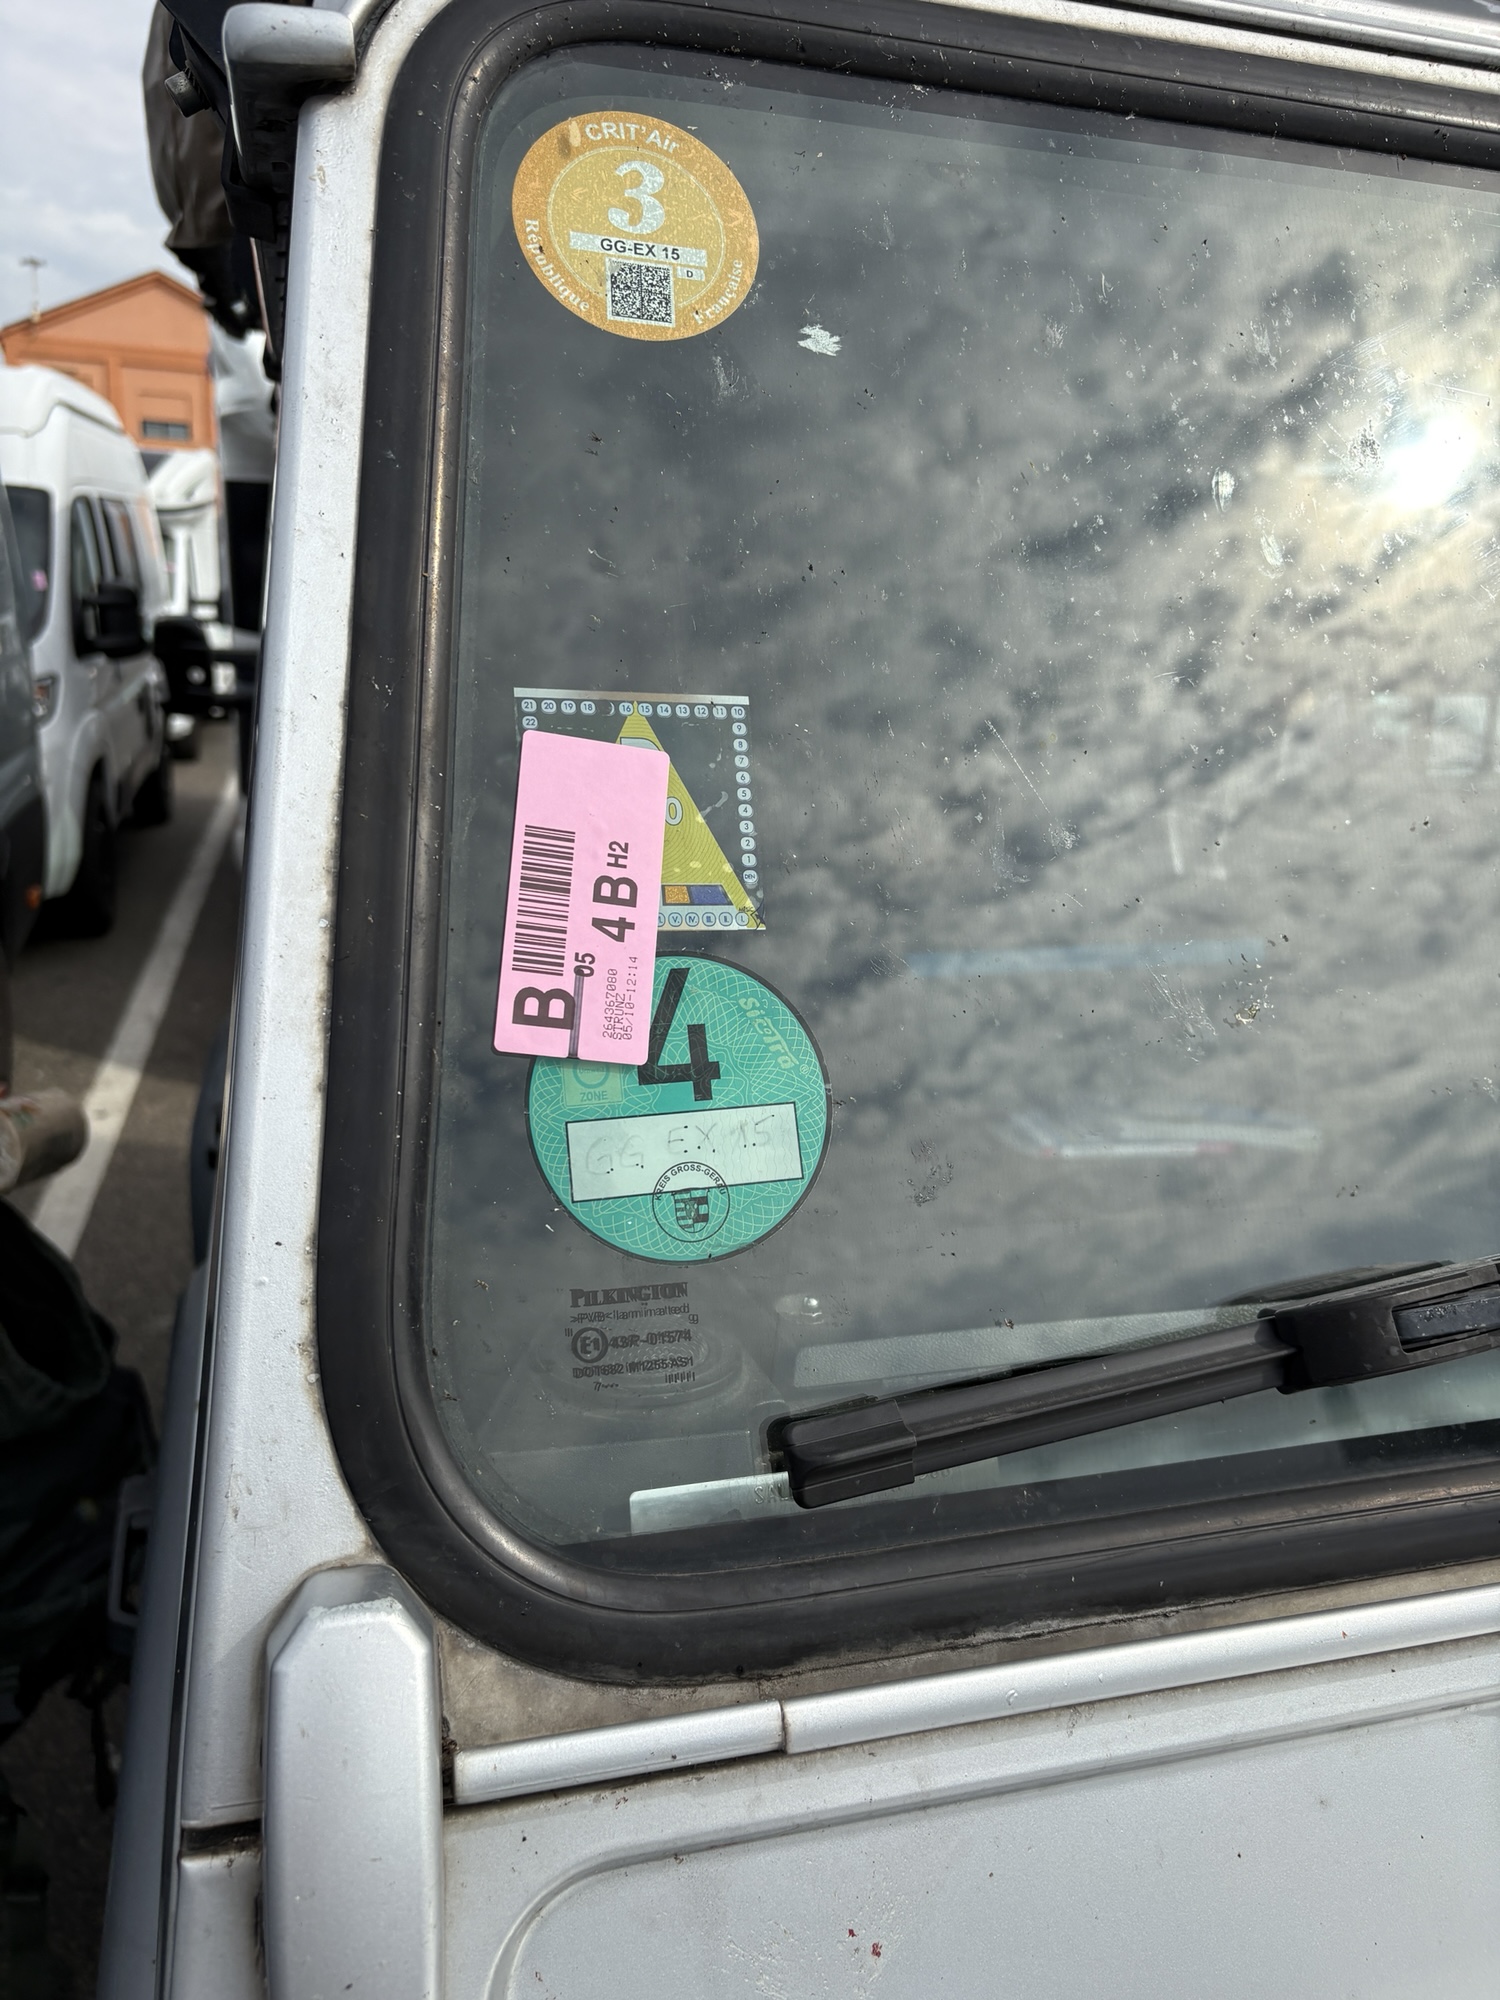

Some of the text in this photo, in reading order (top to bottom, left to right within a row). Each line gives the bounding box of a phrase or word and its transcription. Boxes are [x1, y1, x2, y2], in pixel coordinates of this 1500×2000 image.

[607, 160, 665, 235] 3
[524, 218, 590, 312] République
[600, 238, 681, 261] GG-EX 15
[692, 259, 744, 325] Française
[523, 701, 534, 710] 21
[543, 702, 555, 710] 20
[564, 703, 574, 711] 19
[583, 703, 593, 711] 18
[621, 704, 632, 713] 16
[659, 706, 669, 714] 14
[678, 706, 688, 714] 13
[697, 707, 707, 715] 12
[715, 708, 724, 716] 11
[733, 708, 743, 716] 10
[525, 718, 536, 727] 22
[592, 840, 639, 943] 4 B H2
[573, 951, 596, 978] 05
[512, 986, 576, 1031] B
[602, 968, 619, 1039] 264367080
[612, 992, 626, 1041] STRUNZ
[622, 956, 639, 1041] 05/10-12:14
[638, 967, 721, 1102] 4
[580, 1090, 609, 1103] ZONE
[654, 1174, 671, 1201] KREIS
